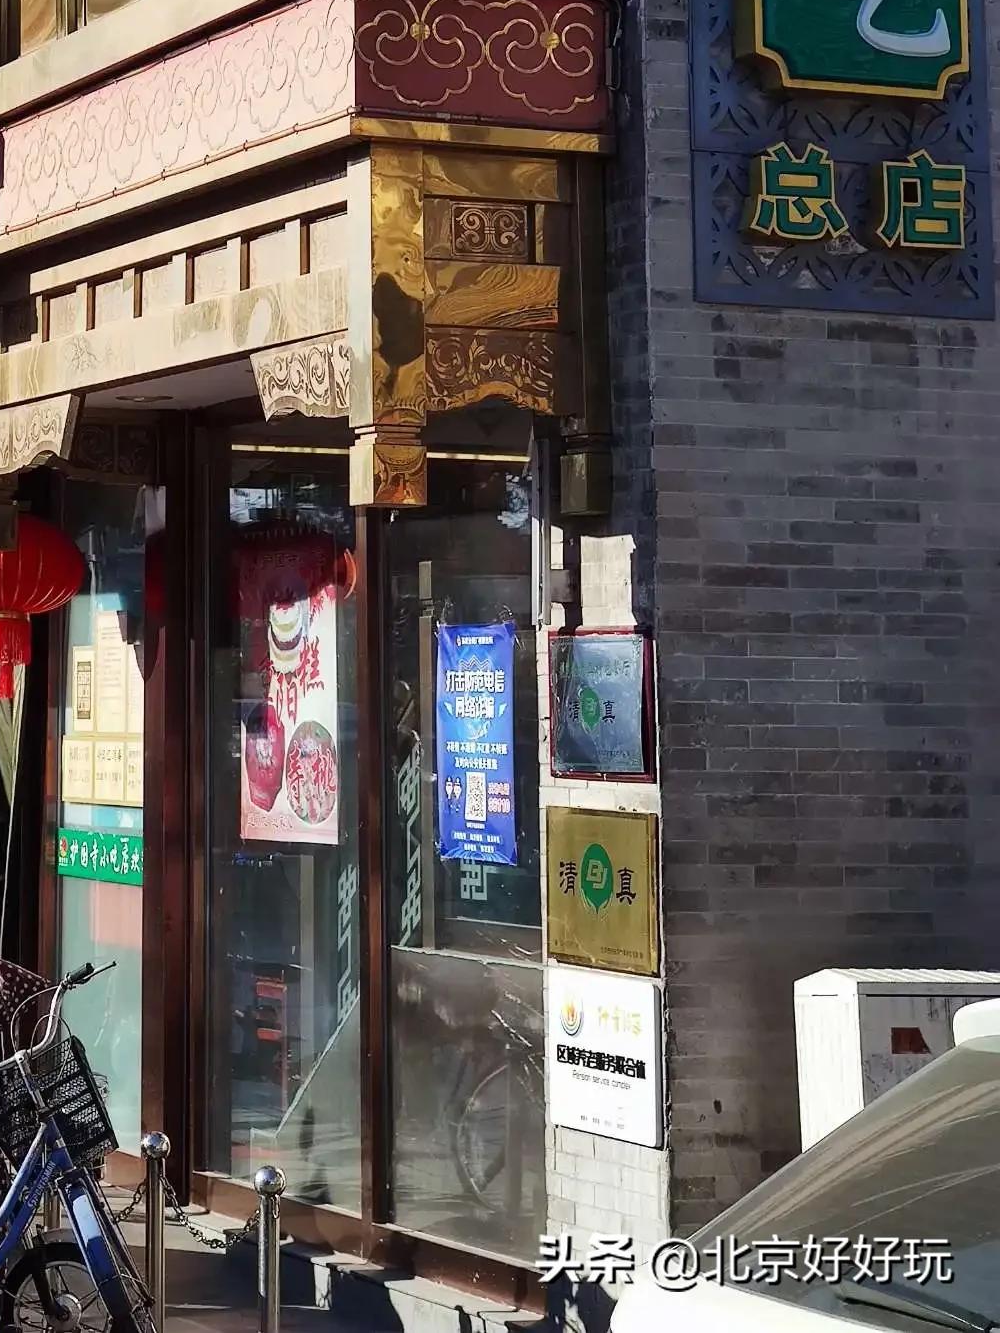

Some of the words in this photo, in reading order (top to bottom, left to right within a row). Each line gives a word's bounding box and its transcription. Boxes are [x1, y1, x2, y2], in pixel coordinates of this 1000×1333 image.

[750, 142, 966, 248] 总店
[70, 837, 144, 875] 护国寺小吃店欢
